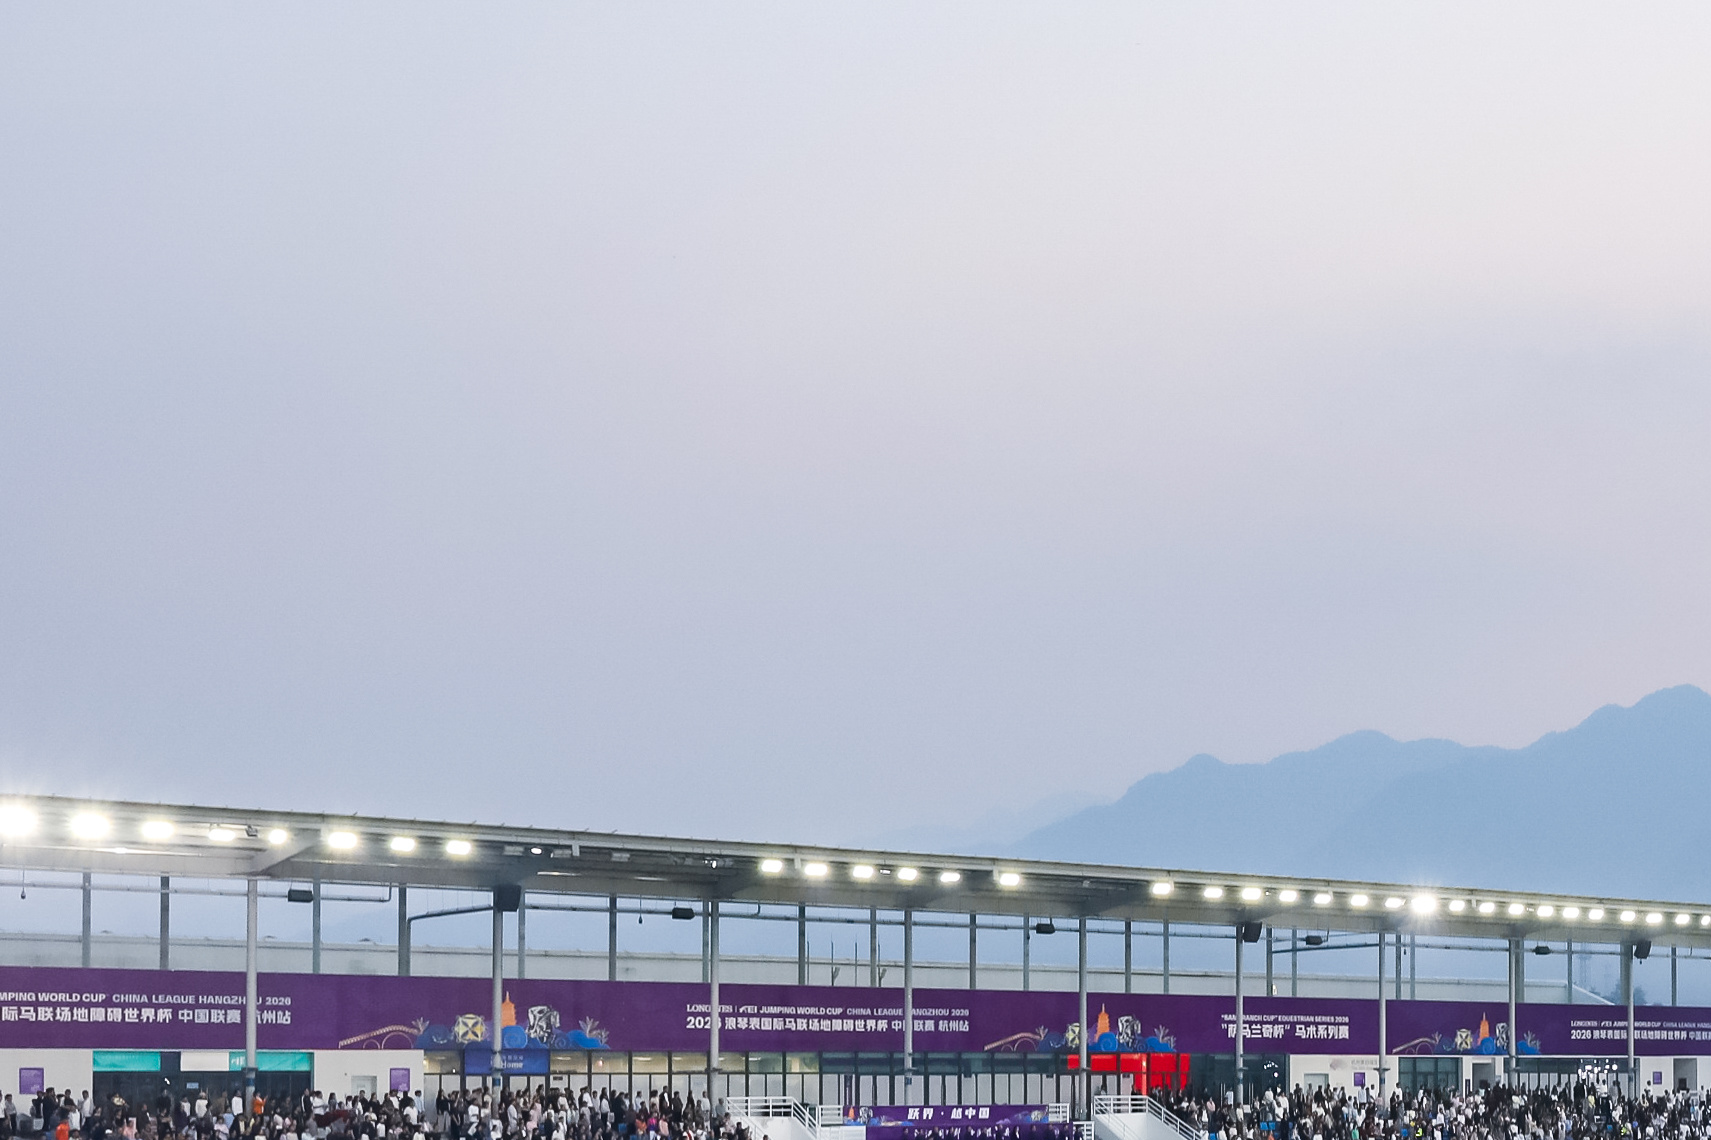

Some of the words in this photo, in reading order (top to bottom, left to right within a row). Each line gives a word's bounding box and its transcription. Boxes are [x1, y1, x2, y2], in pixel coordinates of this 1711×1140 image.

[38, 992, 80, 1003] WORLD
[82, 993, 106, 1003] CUP
[112, 994, 149, 1004] CHINA
[152, 994, 196, 1005] LEAGUE
[199, 995, 262, 1006] HANGZHU
[265, 996, 292, 1006] 2026
[178, 1007, 242, 1025] 中国联赛
[760, 1005, 796, 1015] JUMPING
[797, 1006, 826, 1016] WORLD
[827, 1007, 843, 1016] CUP
[847, 1007, 872, 1017] CHINA
[911, 1008, 949, 1018] ANGZHOU
[892, 1019, 935, 1032] 中联赛
